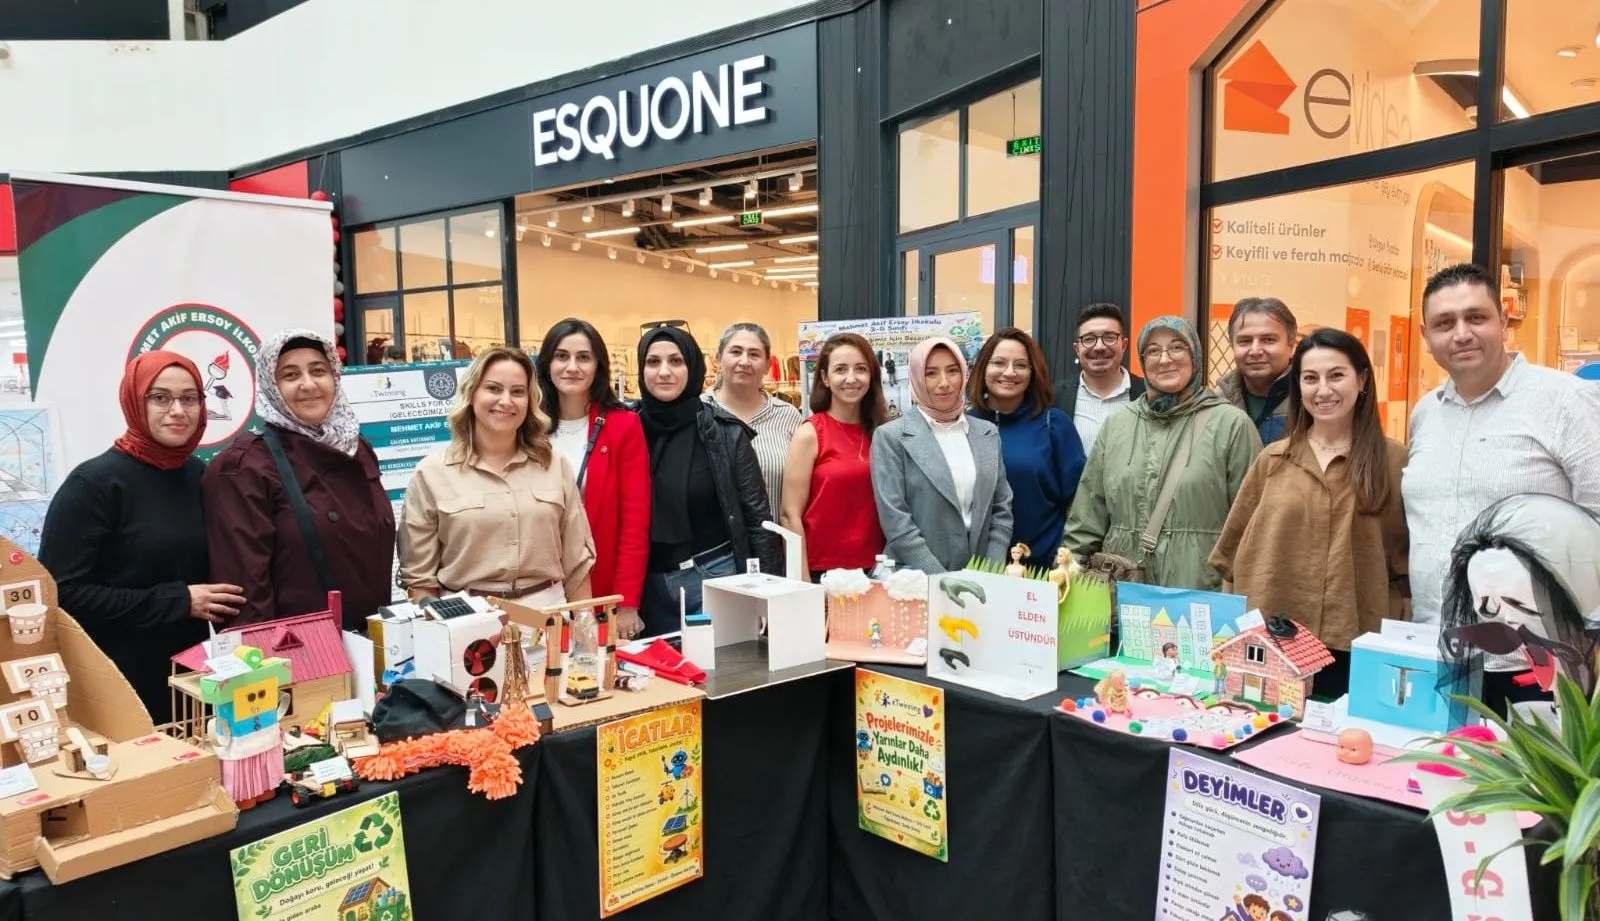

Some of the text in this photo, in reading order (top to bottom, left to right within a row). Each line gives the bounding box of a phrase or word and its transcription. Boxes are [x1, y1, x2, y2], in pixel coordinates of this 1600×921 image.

[533, 54, 767, 166] ESQUONE
[1227, 220, 1326, 239] Kaliteli ürünler
[1226, 245, 1269, 262] Keyifli
[1272, 251, 1288, 260] ve
[1291, 247, 1326, 263] ferah
[160, 312, 188, 332] AKİF
[191, 312, 232, 331] ERSOY
[232, 326, 259, 358] İLKO
[400, 402, 426, 410] SKILLS
[390, 423, 423, 433] MEHMET
[10, 588, 32, 602] 30
[1027, 591, 1038, 601] EL
[1018, 610, 1046, 623] ELDEN
[15, 709, 39, 726] 10
[865, 712, 935, 746] Projelerimizle
[618, 714, 694, 753] İCATLAR
[873, 731, 929, 759] Yarınlar Daha
[877, 747, 924, 774] Aydınlık!
[1183, 769, 1286, 822] DEYİMLER
[272, 826, 329, 867] GERİ
[252, 843, 355, 902] DÖNÜŞÜM
[279, 892, 304, 906] Doğayı
[305, 885, 323, 895] koru,
[325, 871, 353, 888] geleceği
[305, 903, 321, 914] araba
